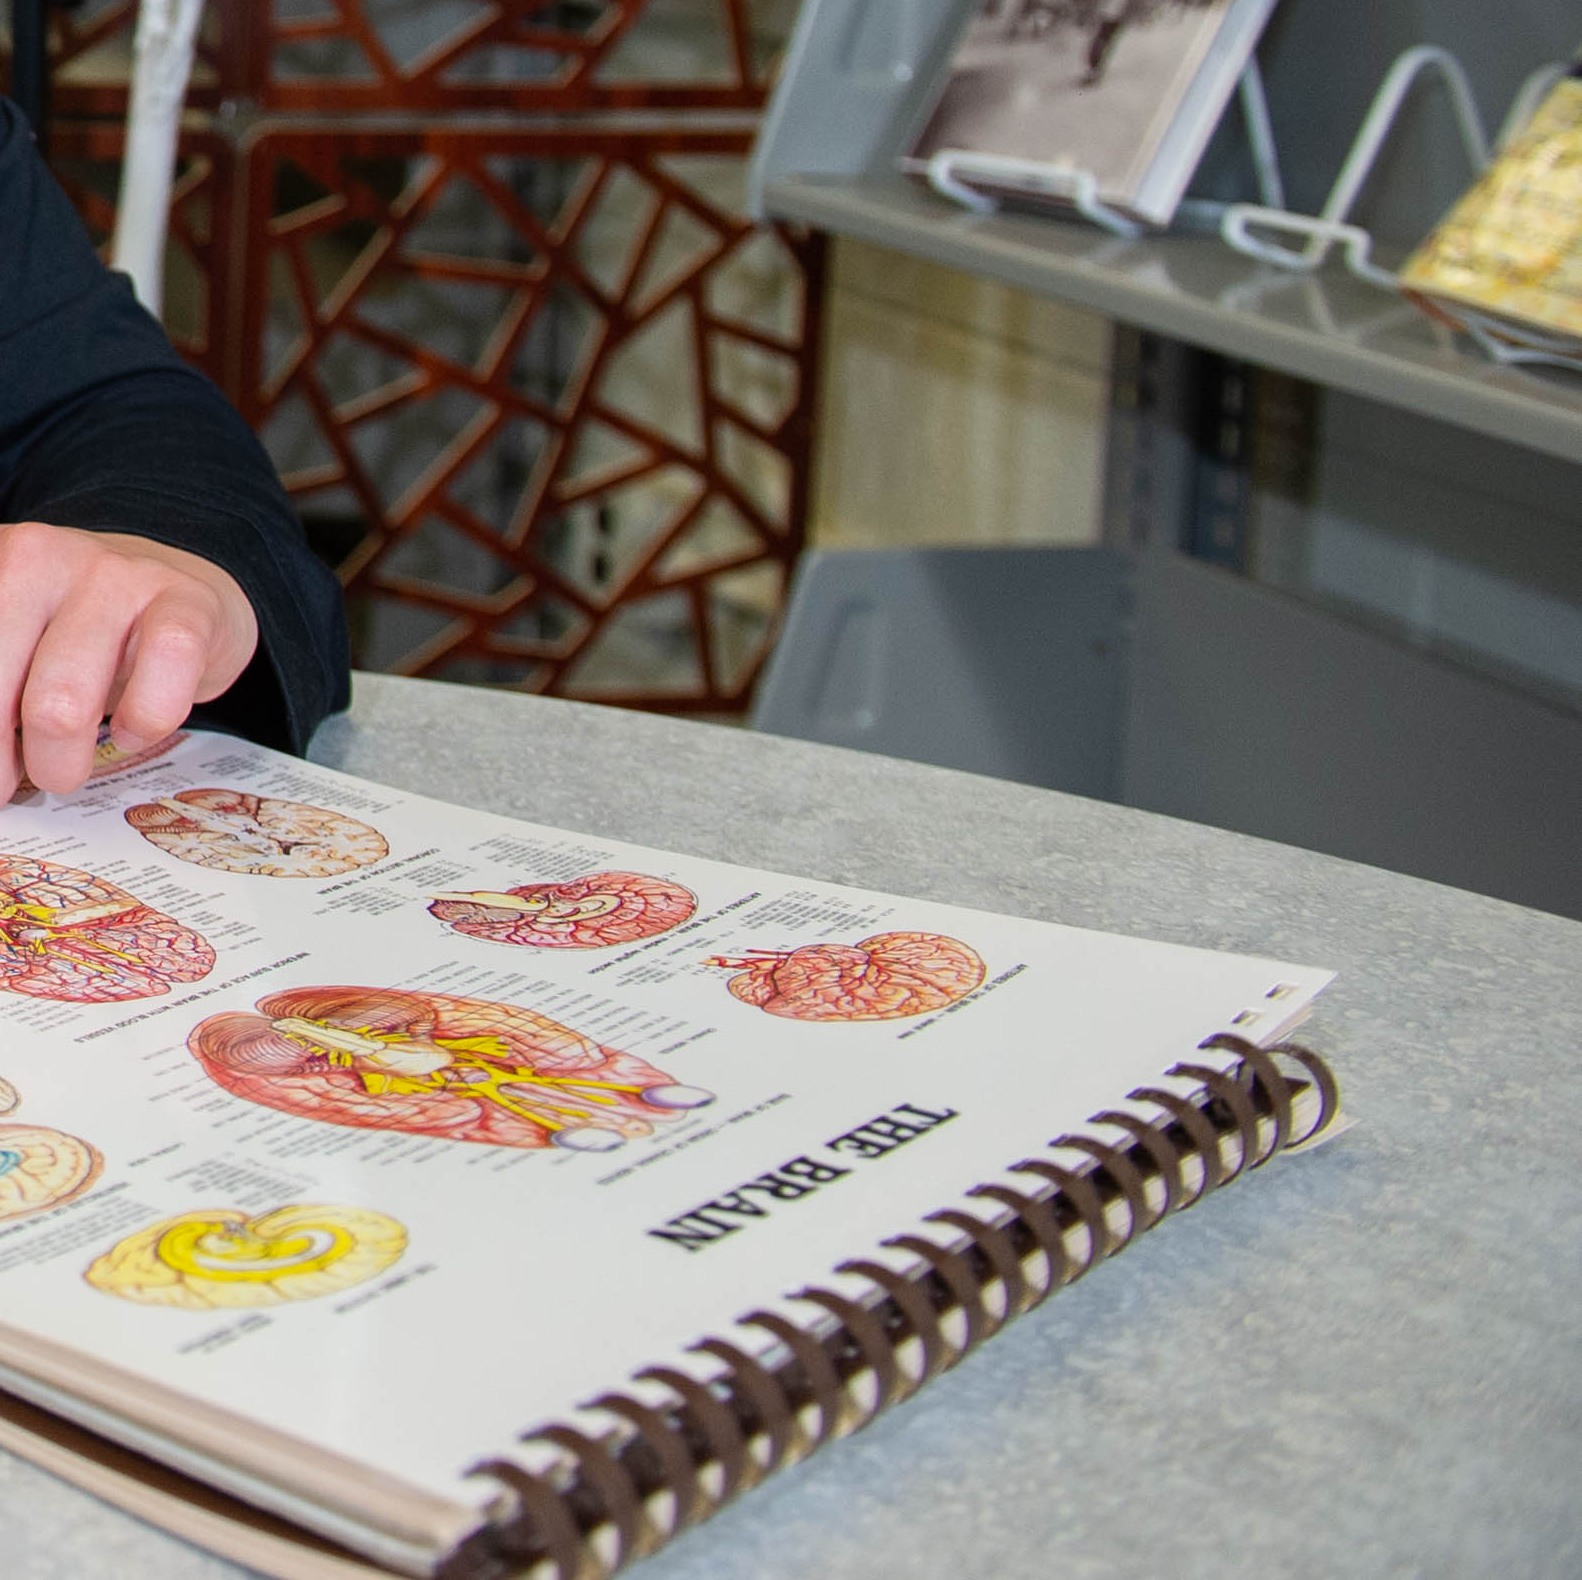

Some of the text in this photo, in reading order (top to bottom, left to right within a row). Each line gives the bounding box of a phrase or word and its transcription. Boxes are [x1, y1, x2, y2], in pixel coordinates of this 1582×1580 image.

[402, 849, 440, 862] CORONAL
[317, 885, 343, 894] BRAIN
[725, 892, 762, 910] ARTERIES
[676, 923, 703, 933] BRAIN
[270, 953, 310, 968] INFERIOR
[230, 967, 272, 983] SURFACE
[992, 964, 1027, 984] ARTERIES
[198, 988, 219, 996] THE
[171, 995, 201, 1006] BRAIN
[944, 1000, 971, 1012] BRAIN
[147, 1006, 174, 1016] WITH
[115, 1014, 149, 1028] BLOOD
[74, 1027, 118, 1043] VESSELS
[825, 1103, 961, 1161] THE
[647, 1155, 853, 1253] BRAIN
